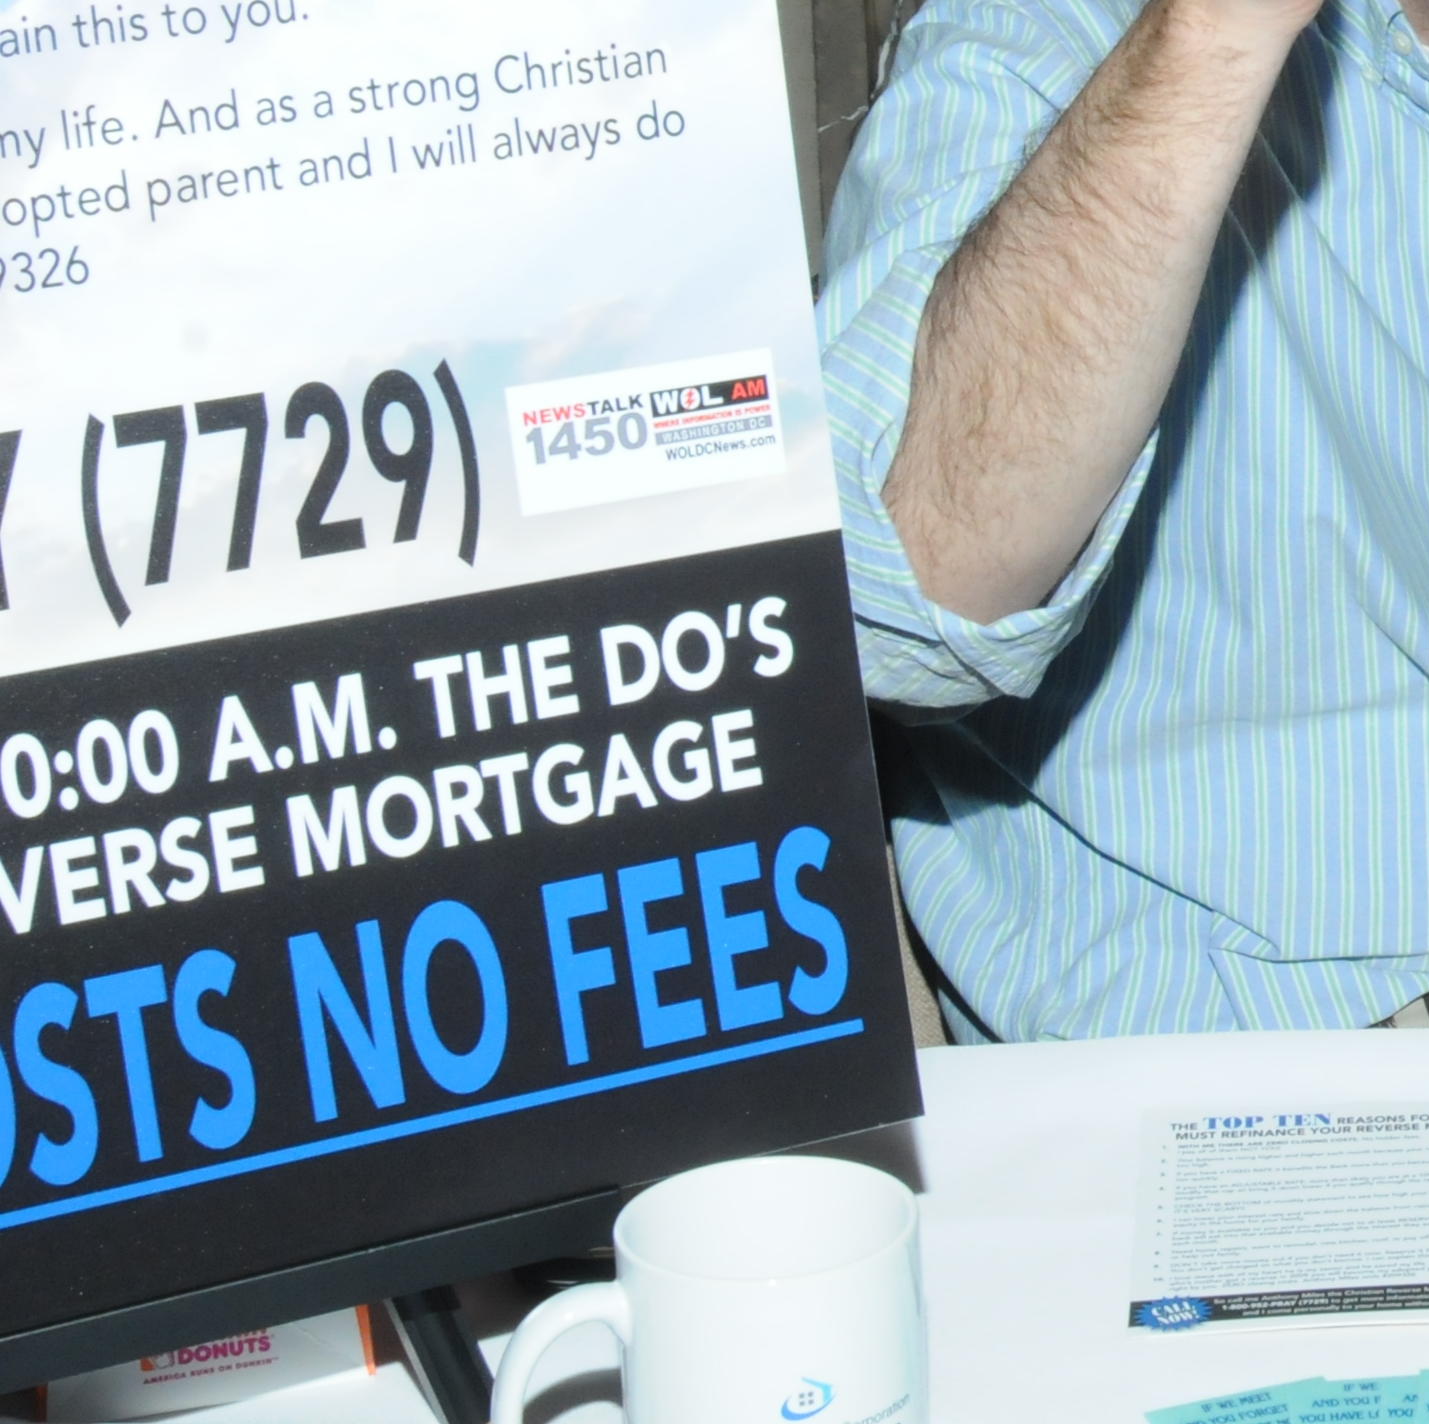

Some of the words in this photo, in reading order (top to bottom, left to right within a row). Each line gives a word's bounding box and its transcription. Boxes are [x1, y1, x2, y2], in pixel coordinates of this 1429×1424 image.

[71, 4, 148, 49] this
[161, 4, 207, 38] to
[60, 104, 138, 150] life.
[155, 88, 240, 139] And
[256, 95, 297, 126] as
[313, 90, 334, 119] a
[348, 72, 480, 114] strong
[494, 43, 667, 94] Christian
[1, 170, 130, 239] opted
[146, 157, 284, 223] parent
[299, 137, 372, 187] and
[388, 136, 397, 174] I
[411, 123, 477, 170] will
[493, 117, 621, 161] always
[636, 99, 685, 141] do
[652, 384, 724, 415] WOL
[731, 378, 766, 400] AM
[525, 412, 649, 465] 1450
[662, 422, 745, 444] WASHINGTON
[749, 416, 767, 428] DC
[665, 433, 776, 461] WOLDCNews.com
[81, 358, 481, 628] (7729)
[0, 710, 179, 820] 0:00
[209, 672, 398, 783] A.M.
[414, 635, 581, 740] THE
[602, 596, 795, 694] DO'S
[0, 806, 266, 935] VERSE
[286, 709, 764, 879] MORTGAGE
[0, 949, 257, 1188] STS
[288, 898, 509, 1124] NO
[540, 825, 851, 1068] FEES
[1203, 1116, 1264, 1129] TOP
[1274, 1113, 1331, 1127] TEN
[1337, 1114, 1405, 1124] REASONS
[1221, 1128, 1305, 1139] REFINANCE
[1356, 1123, 1420, 1133] REVERSE
[177, 1335, 271, 1365] DONUTS
